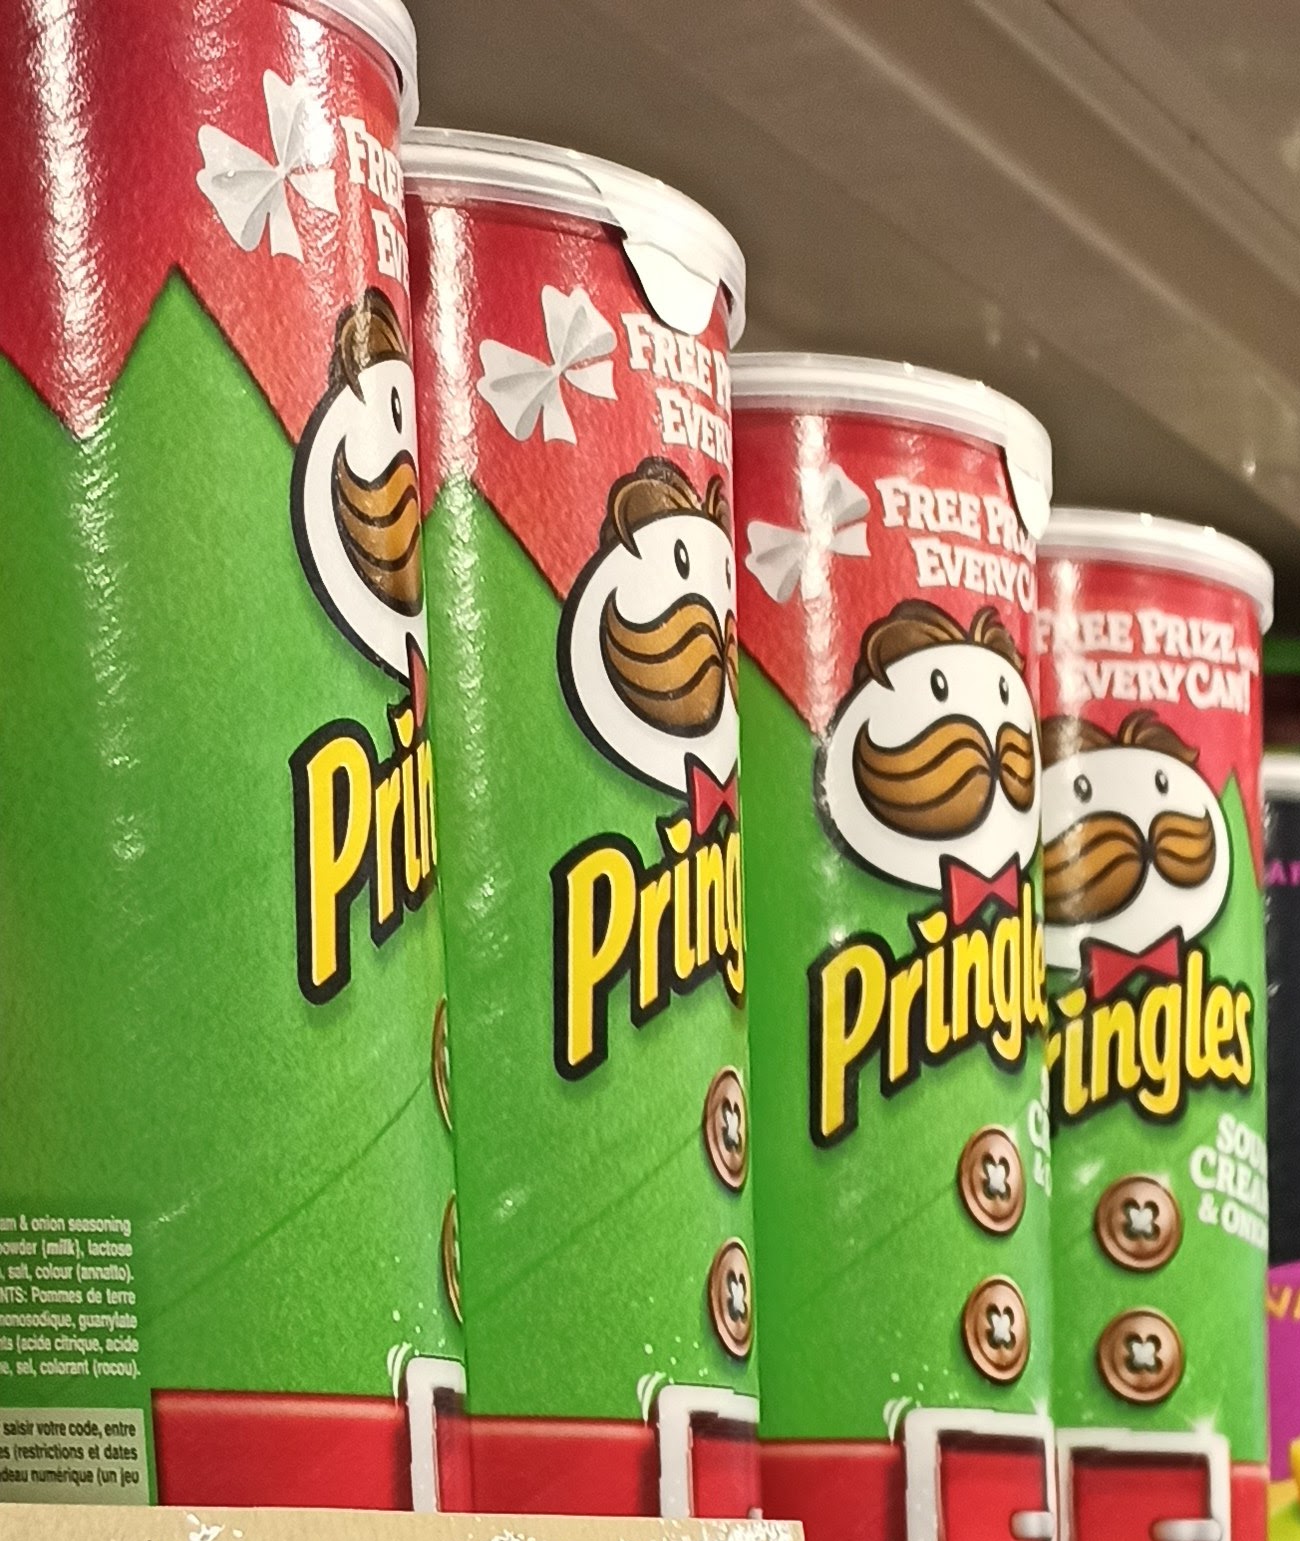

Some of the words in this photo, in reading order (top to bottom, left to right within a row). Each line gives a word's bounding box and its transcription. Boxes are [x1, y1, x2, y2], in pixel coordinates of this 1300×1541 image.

[620, 312, 713, 399] FREE
[875, 475, 981, 541] FREE
[1048, 949, 1254, 1117] ingles
[31, 1215, 65, 1232] onion
[68, 1215, 132, 1236] seasoning
[88, 1240, 133, 1257] lactose
[35, 1264, 73, 1280] colour
[31, 1287, 83, 1304] Pommes
[86, 1288, 103, 1304] de
[106, 1288, 136, 1305] terre
[78, 1311, 138, 1332] guanylate
[16, 1334, 51, 1353] (acide
[54, 1334, 103, 1355] citrique,
[106, 1335, 139, 1353] acide
[16, 1358, 37, 1377] sel,
[39, 1358, 89, 1376] colorant
[3, 1419, 34, 1437] saisir
[37, 1420, 67, 1437] votre
[68, 1419, 103, 1439] code,
[104, 1420, 136, 1437] entre
[13, 1443, 84, 1463] (restrictions
[87, 1445, 101, 1461] et
[103, 1444, 138, 1461] dates
[30, 1466, 94, 1487] numérique
